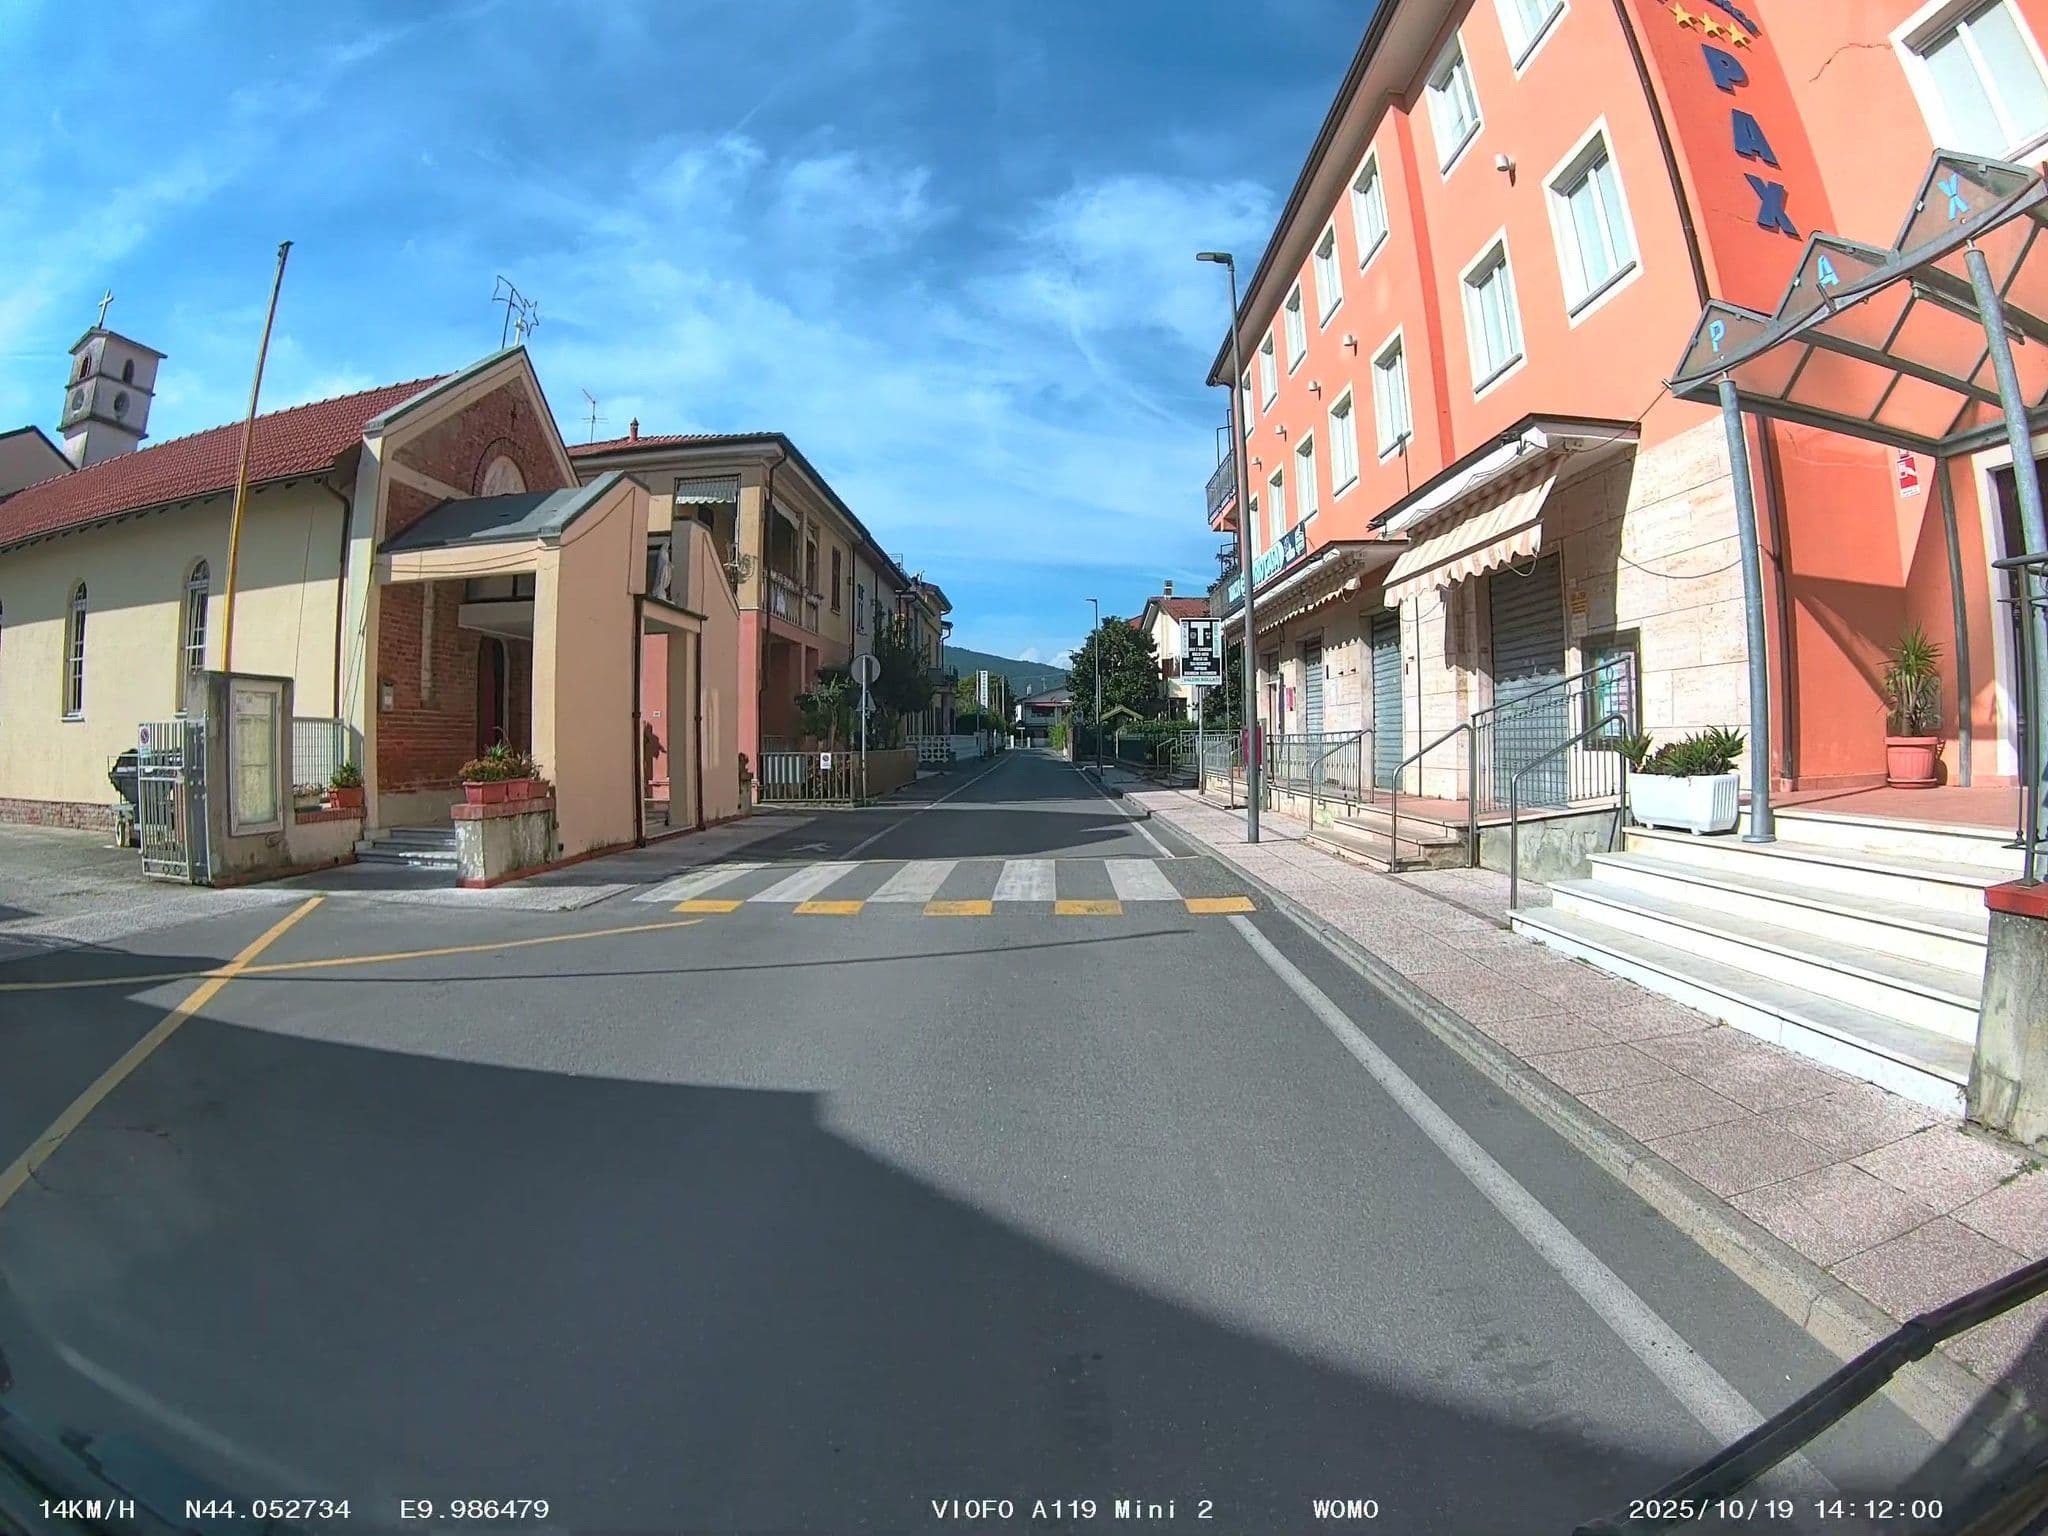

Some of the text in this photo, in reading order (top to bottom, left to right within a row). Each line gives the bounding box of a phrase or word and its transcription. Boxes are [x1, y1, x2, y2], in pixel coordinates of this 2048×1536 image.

[1701, 43, 1801, 240] PAX
[1708, 172, 1970, 352] PAX
[1190, 621, 1210, 646] T
